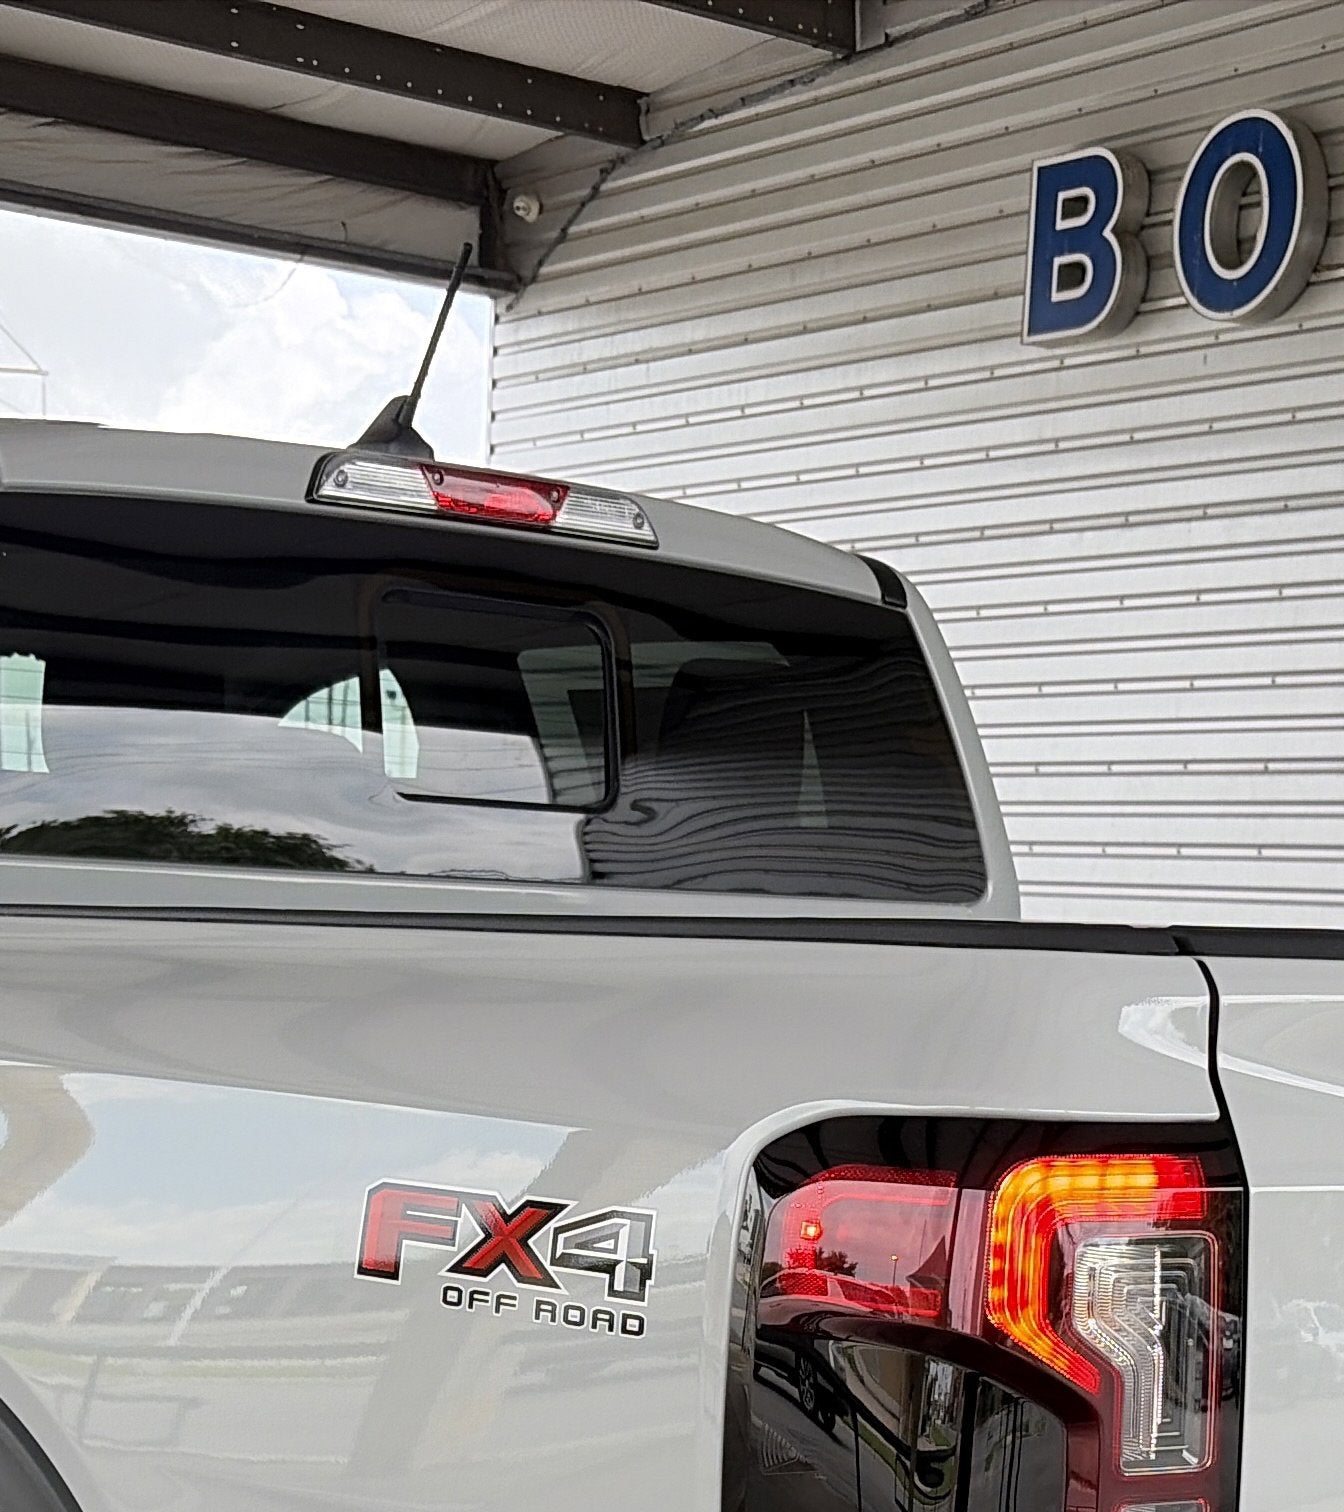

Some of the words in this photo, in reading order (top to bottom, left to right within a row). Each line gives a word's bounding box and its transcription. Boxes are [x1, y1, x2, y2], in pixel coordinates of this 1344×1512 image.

[354, 1178, 657, 1306] FX4
[440, 1284, 518, 1316] OFF
[532, 1298, 647, 1339] ROAD
